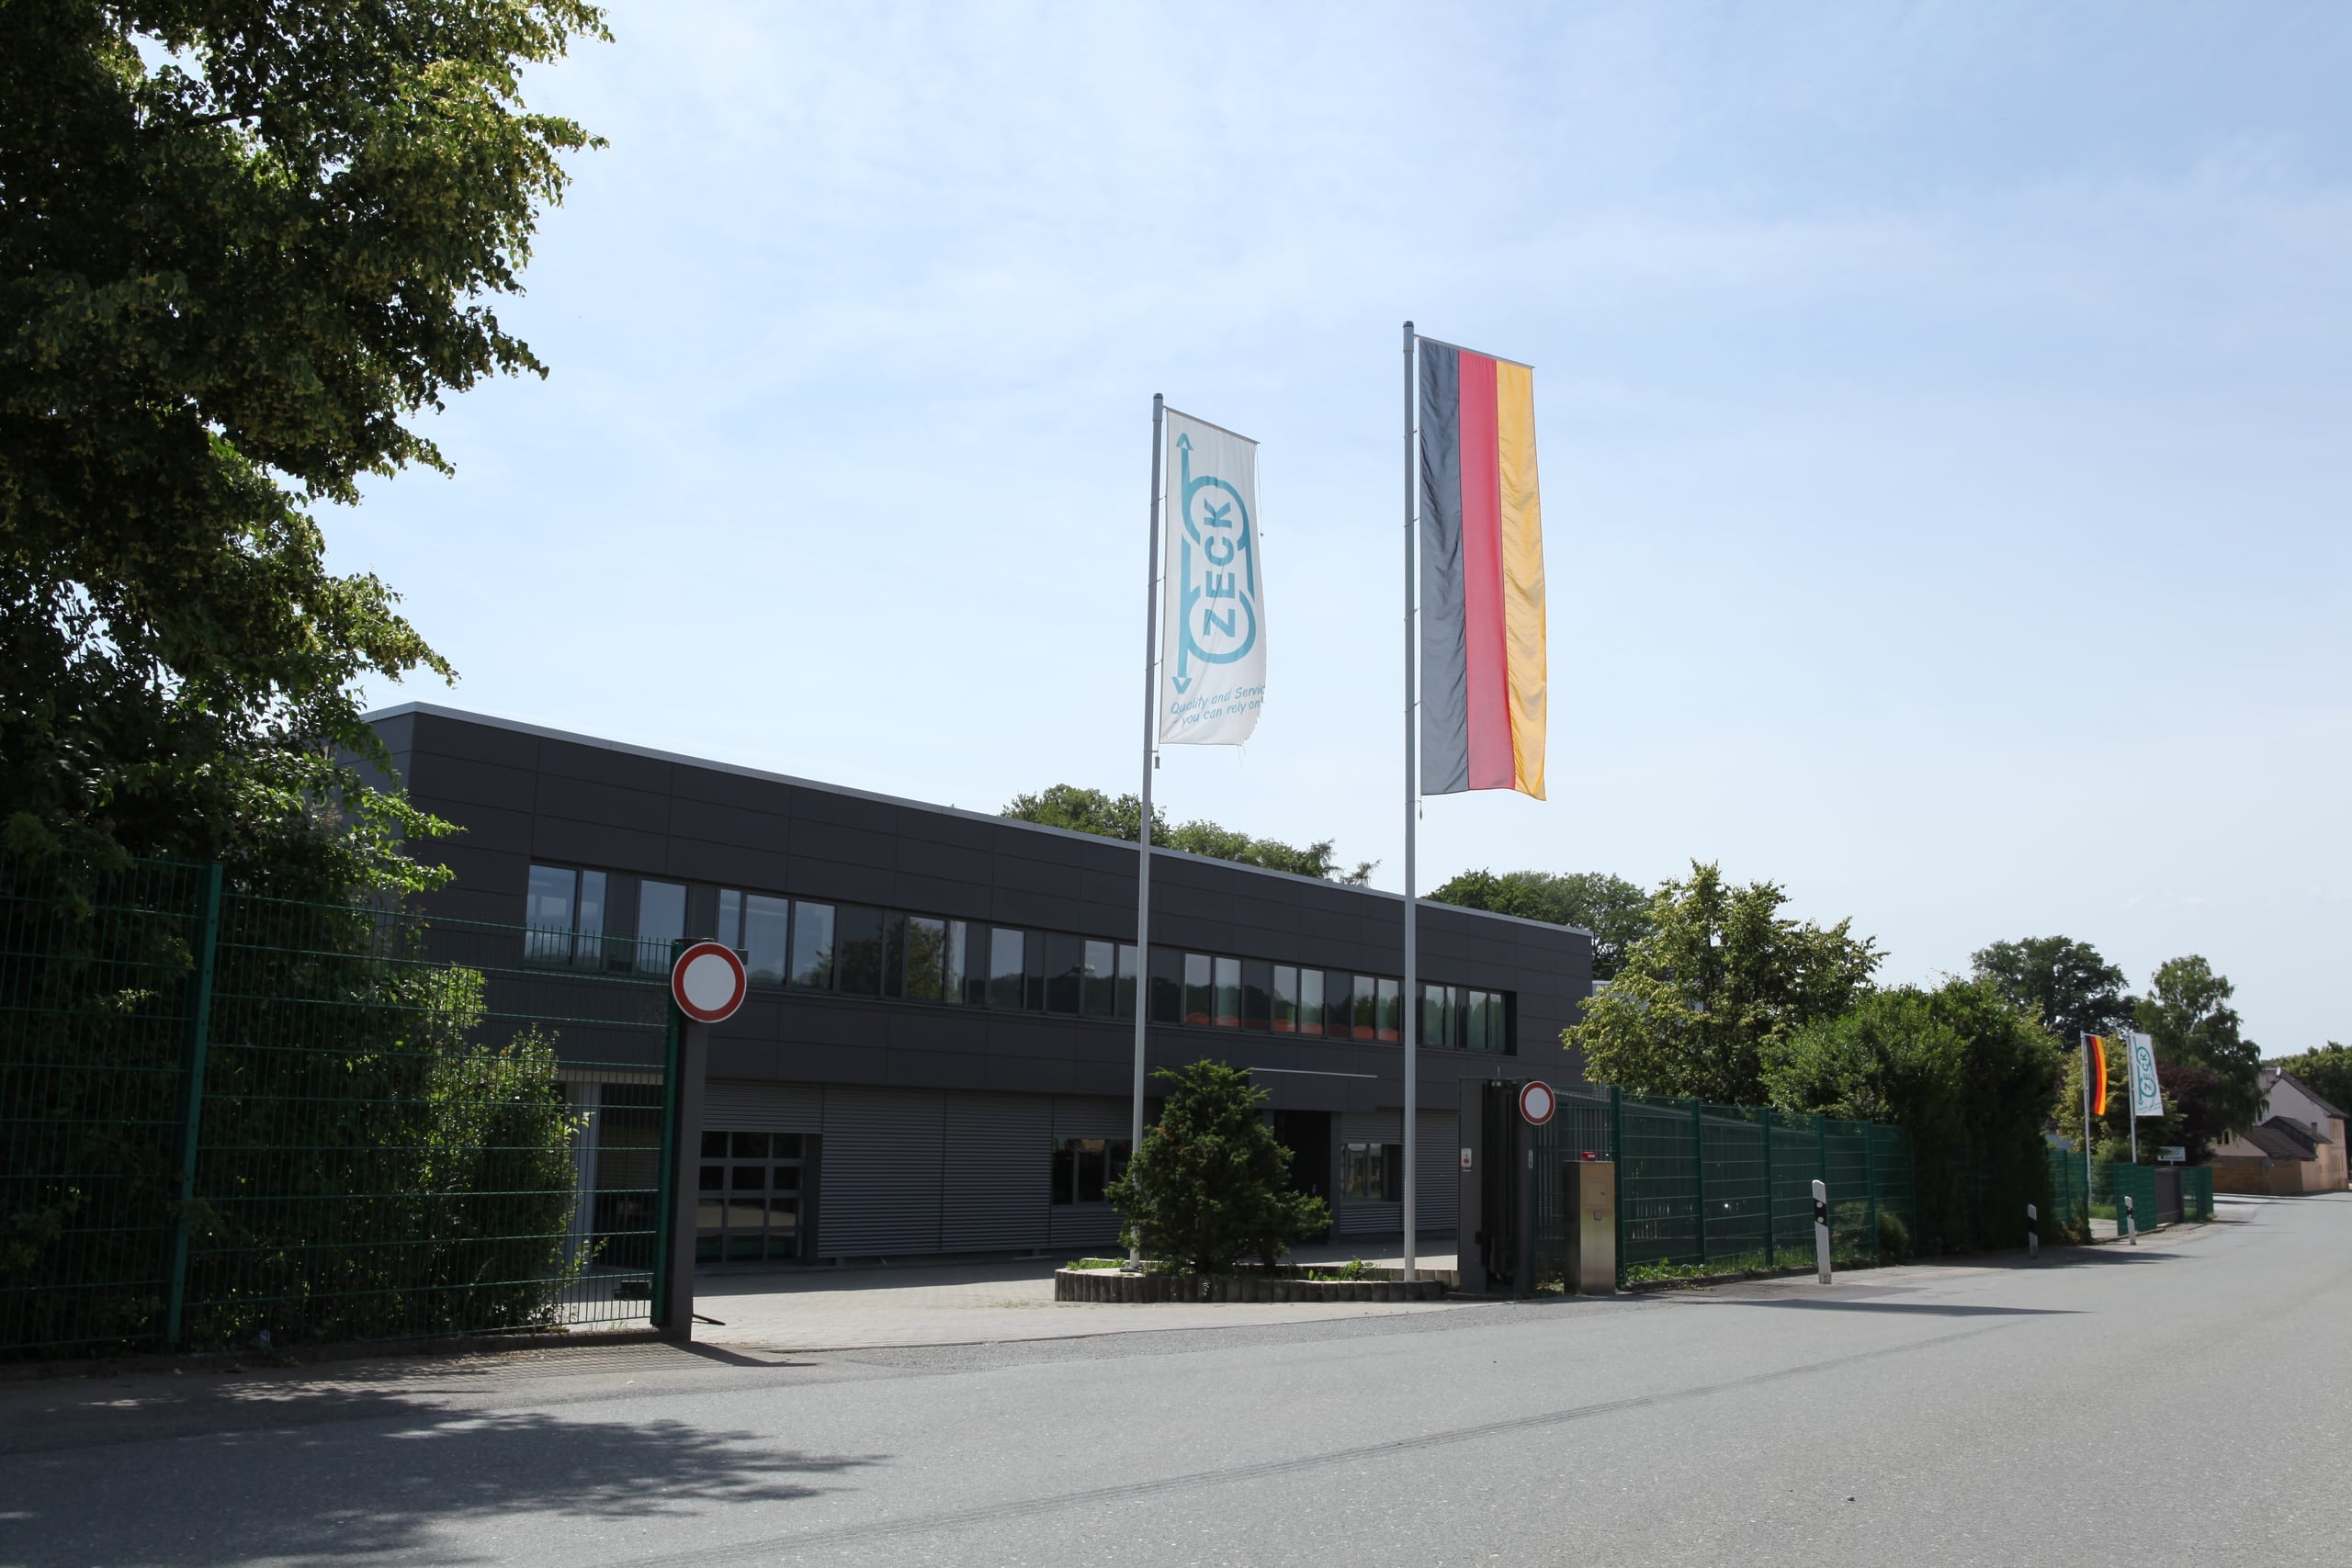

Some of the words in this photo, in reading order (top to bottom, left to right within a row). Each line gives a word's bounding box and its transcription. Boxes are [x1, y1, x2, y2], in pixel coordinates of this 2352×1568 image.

[1204, 497, 1236, 637] ZECK
[1170, 694, 1208, 715] Quality
[1211, 687, 1233, 705] and
[1234, 683, 1266, 699] Servic
[1182, 714, 1200, 728] you
[1204, 708, 1223, 719] can
[1227, 701, 1247, 715] rely
[2140, 1053, 2152, 1091] ZECK
